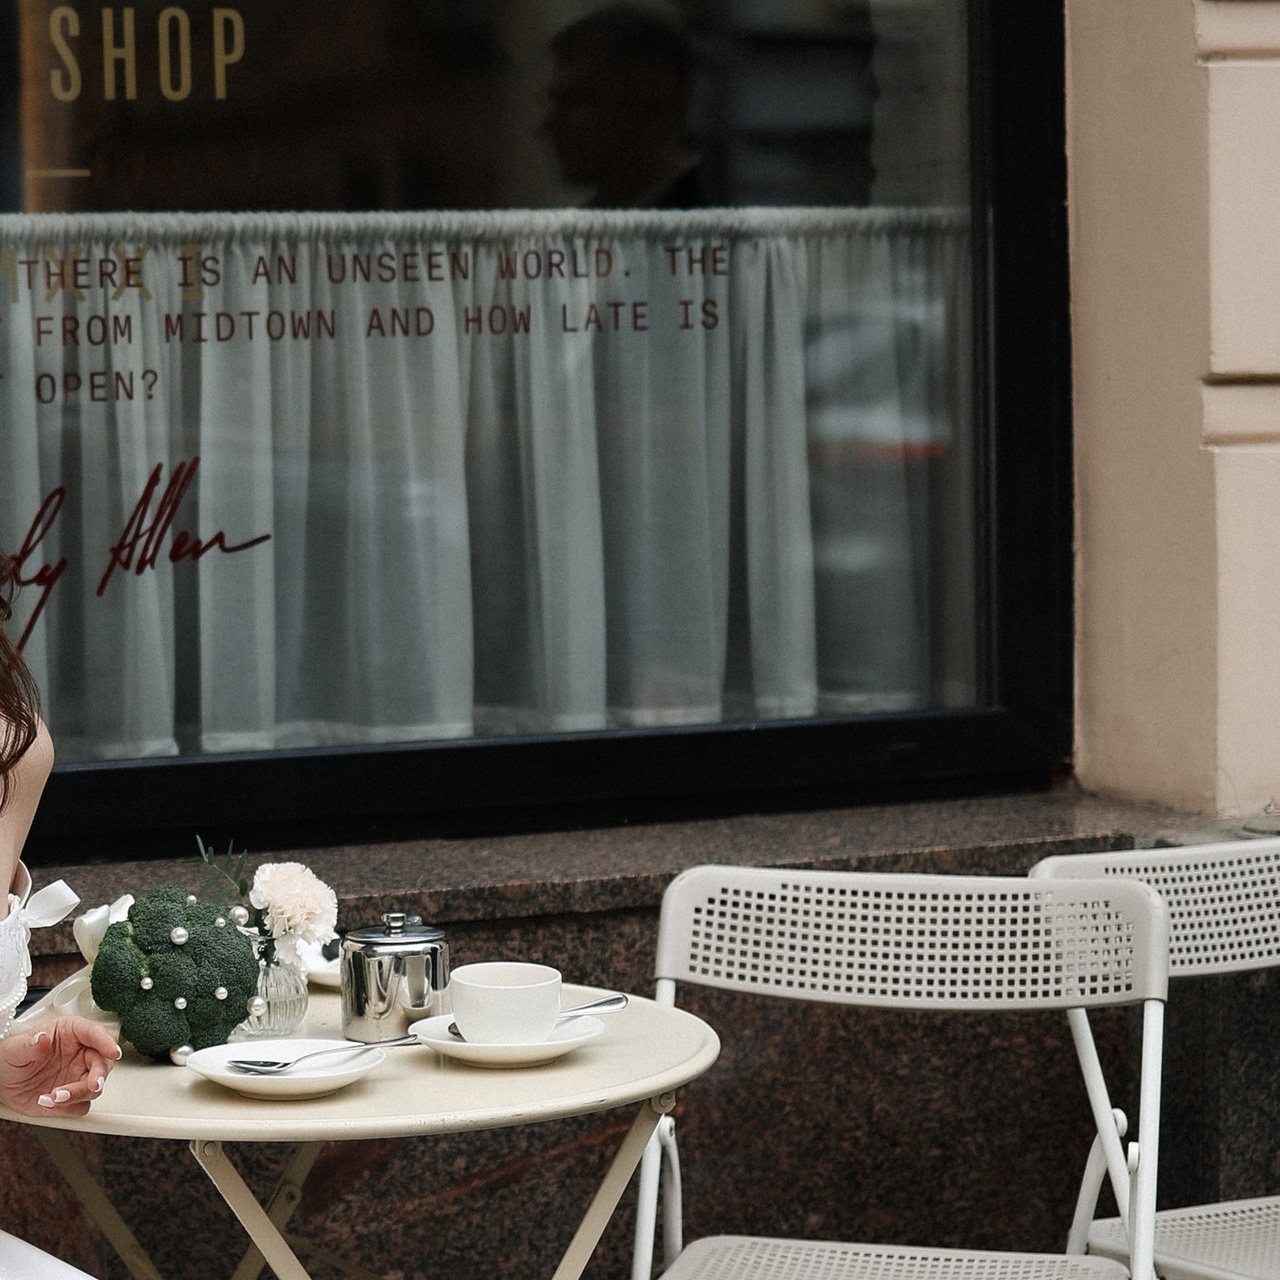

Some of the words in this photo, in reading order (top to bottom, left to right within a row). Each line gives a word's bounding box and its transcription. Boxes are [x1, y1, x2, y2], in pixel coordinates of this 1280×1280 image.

[49, 6, 246, 102] SHOP
[19, 257, 144, 290] THERE
[178, 255, 221, 288] IS
[252, 254, 297, 285] AN
[327, 251, 470, 284] UNSEEN
[497, 248, 632, 280] WORLD.
[664, 245, 731, 277] THE
[35, 314, 133, 347] FROM
[164, 310, 336, 343] MIDTOWN
[366, 307, 435, 338] AND
[464, 304, 532, 335] HOW
[562, 301, 650, 333] LATE
[679, 298, 720, 331] IS
[35, 369, 159, 406] OPEN?
[95, 456, 272, 597] Allen
